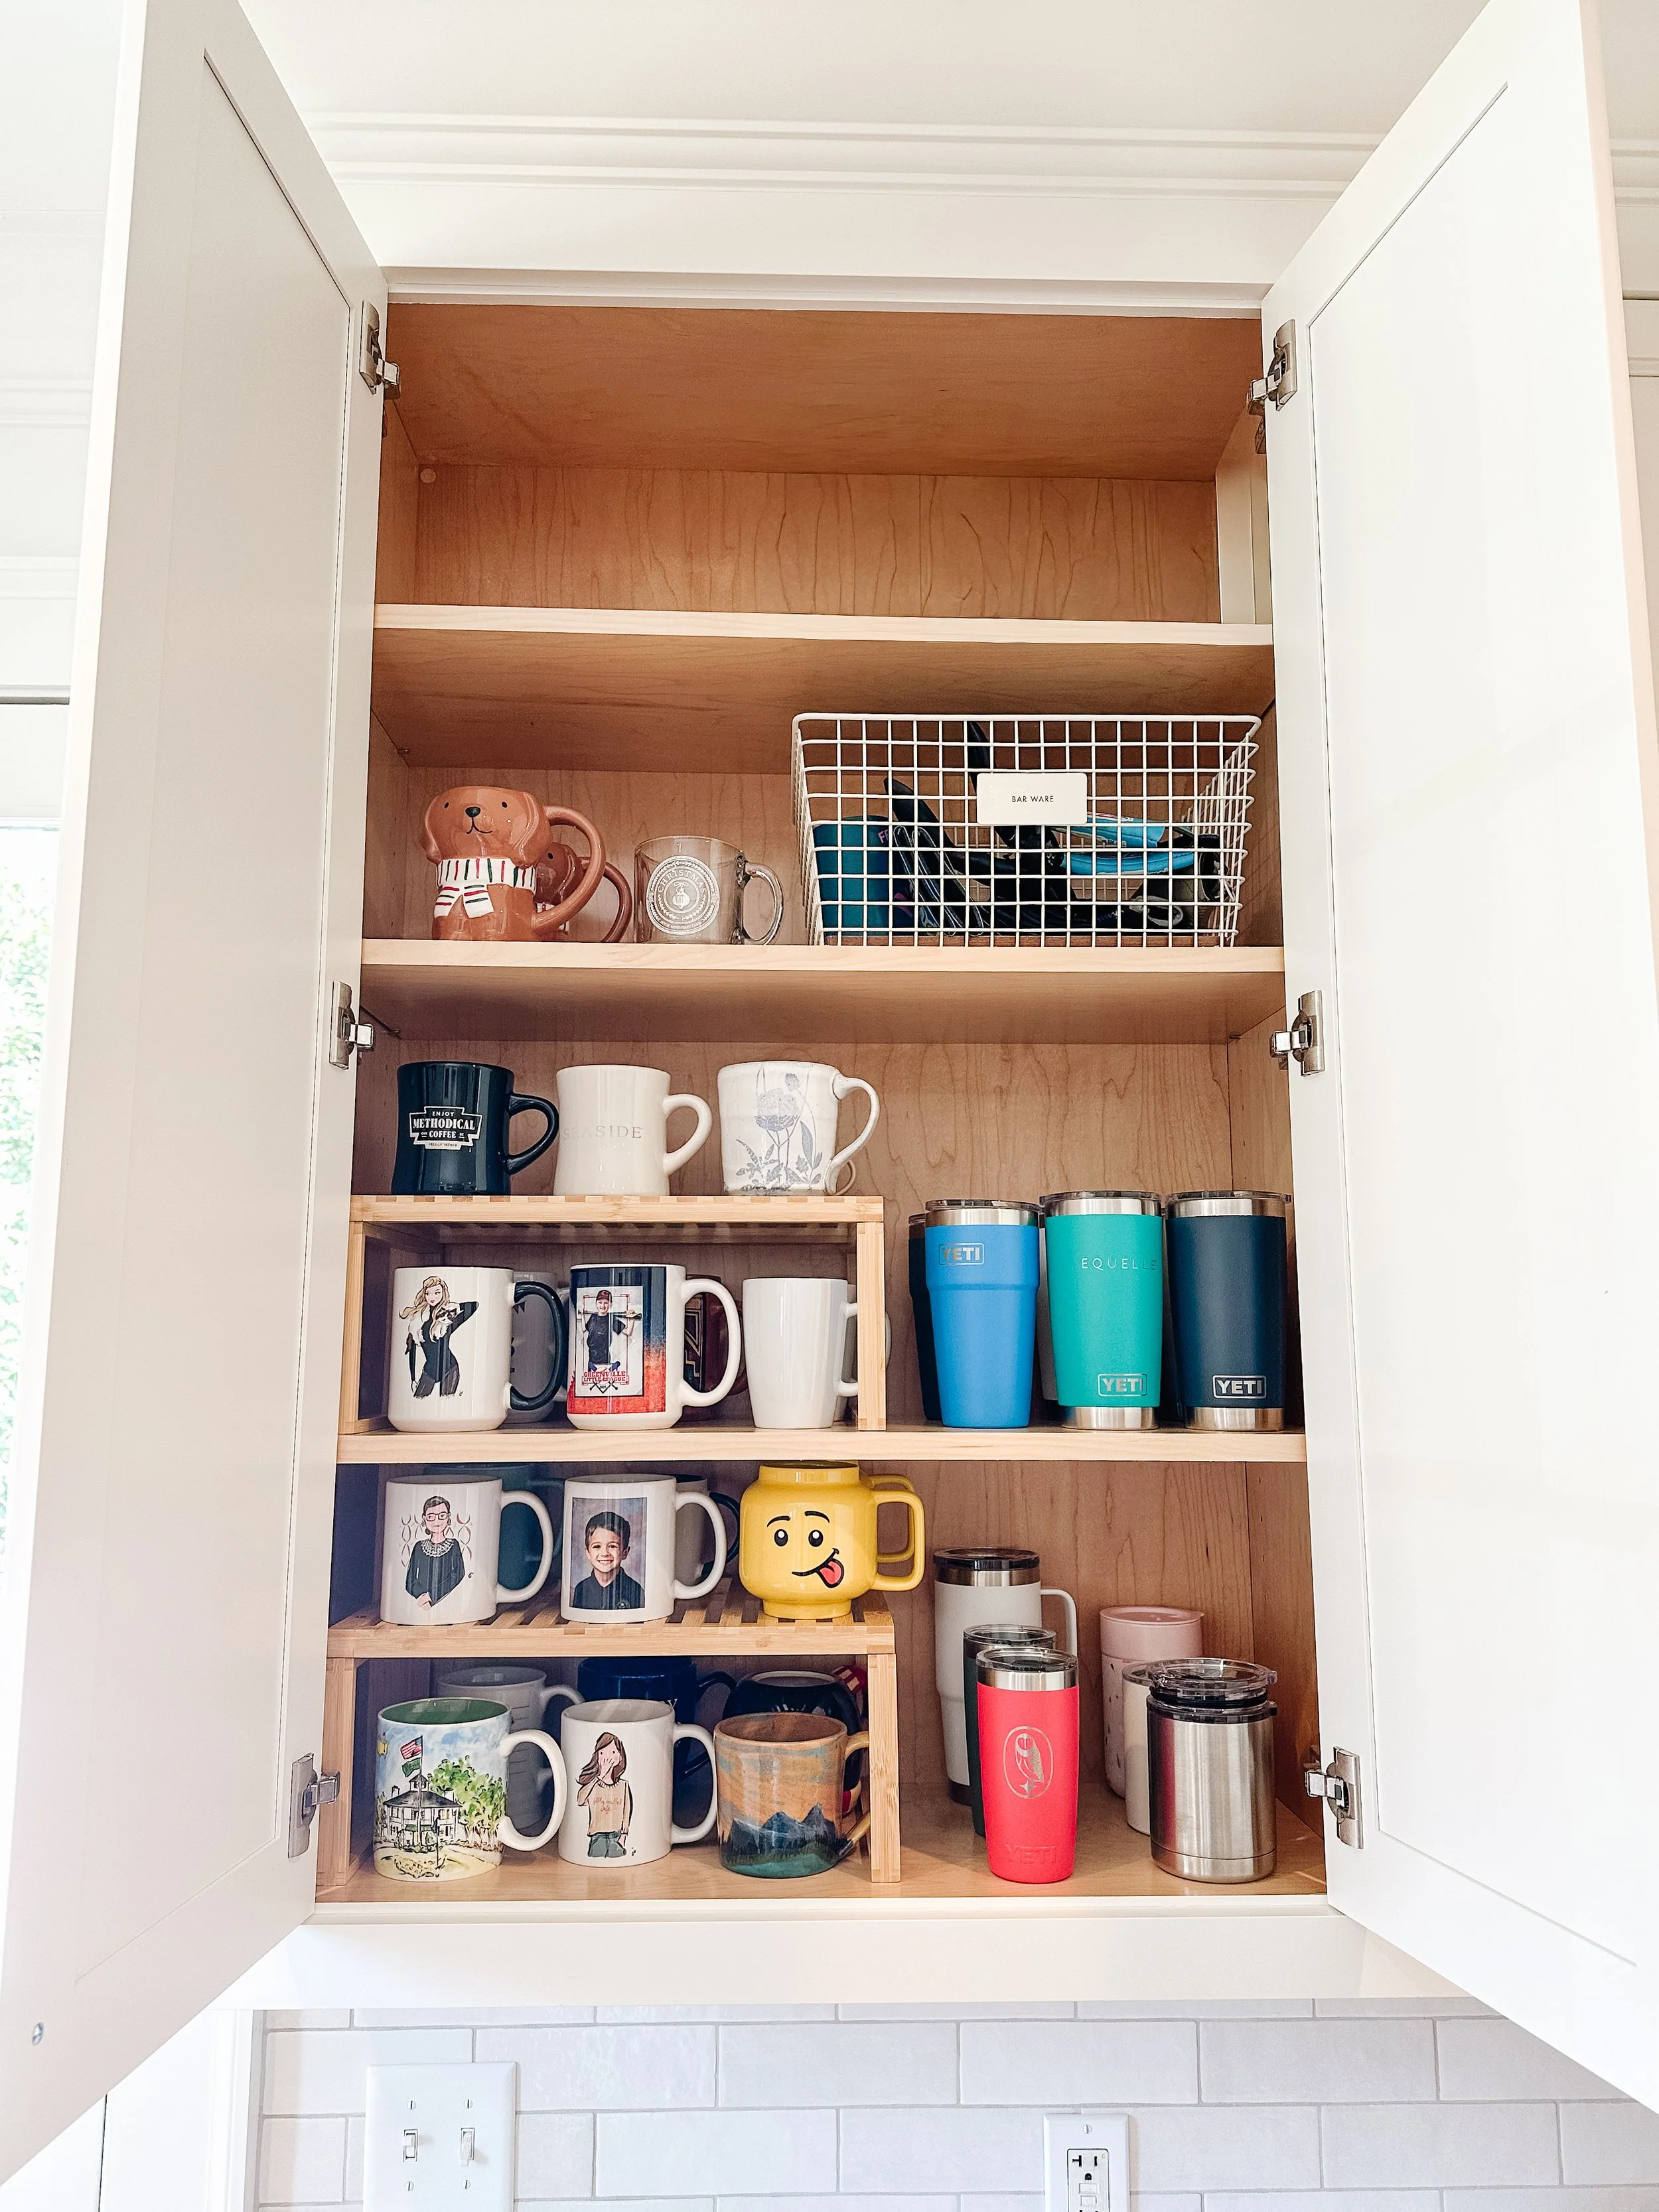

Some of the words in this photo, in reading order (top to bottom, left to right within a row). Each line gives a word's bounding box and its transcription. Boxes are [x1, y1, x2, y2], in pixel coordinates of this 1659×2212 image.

[658, 869, 707, 893] CHRISTMAS
[413, 1118, 476, 1130] METHODICAL
[429, 1130, 457, 1139] COFFEE
[563, 1125, 642, 1140] SEASIDE
[942, 1247, 980, 1261] YETI
[1081, 1257, 1157, 1271] EQUELLE
[1102, 1378, 1143, 1392] YETI
[1216, 1380, 1262, 1395] YETI
[1002, 1844, 1056, 1864] YETI
